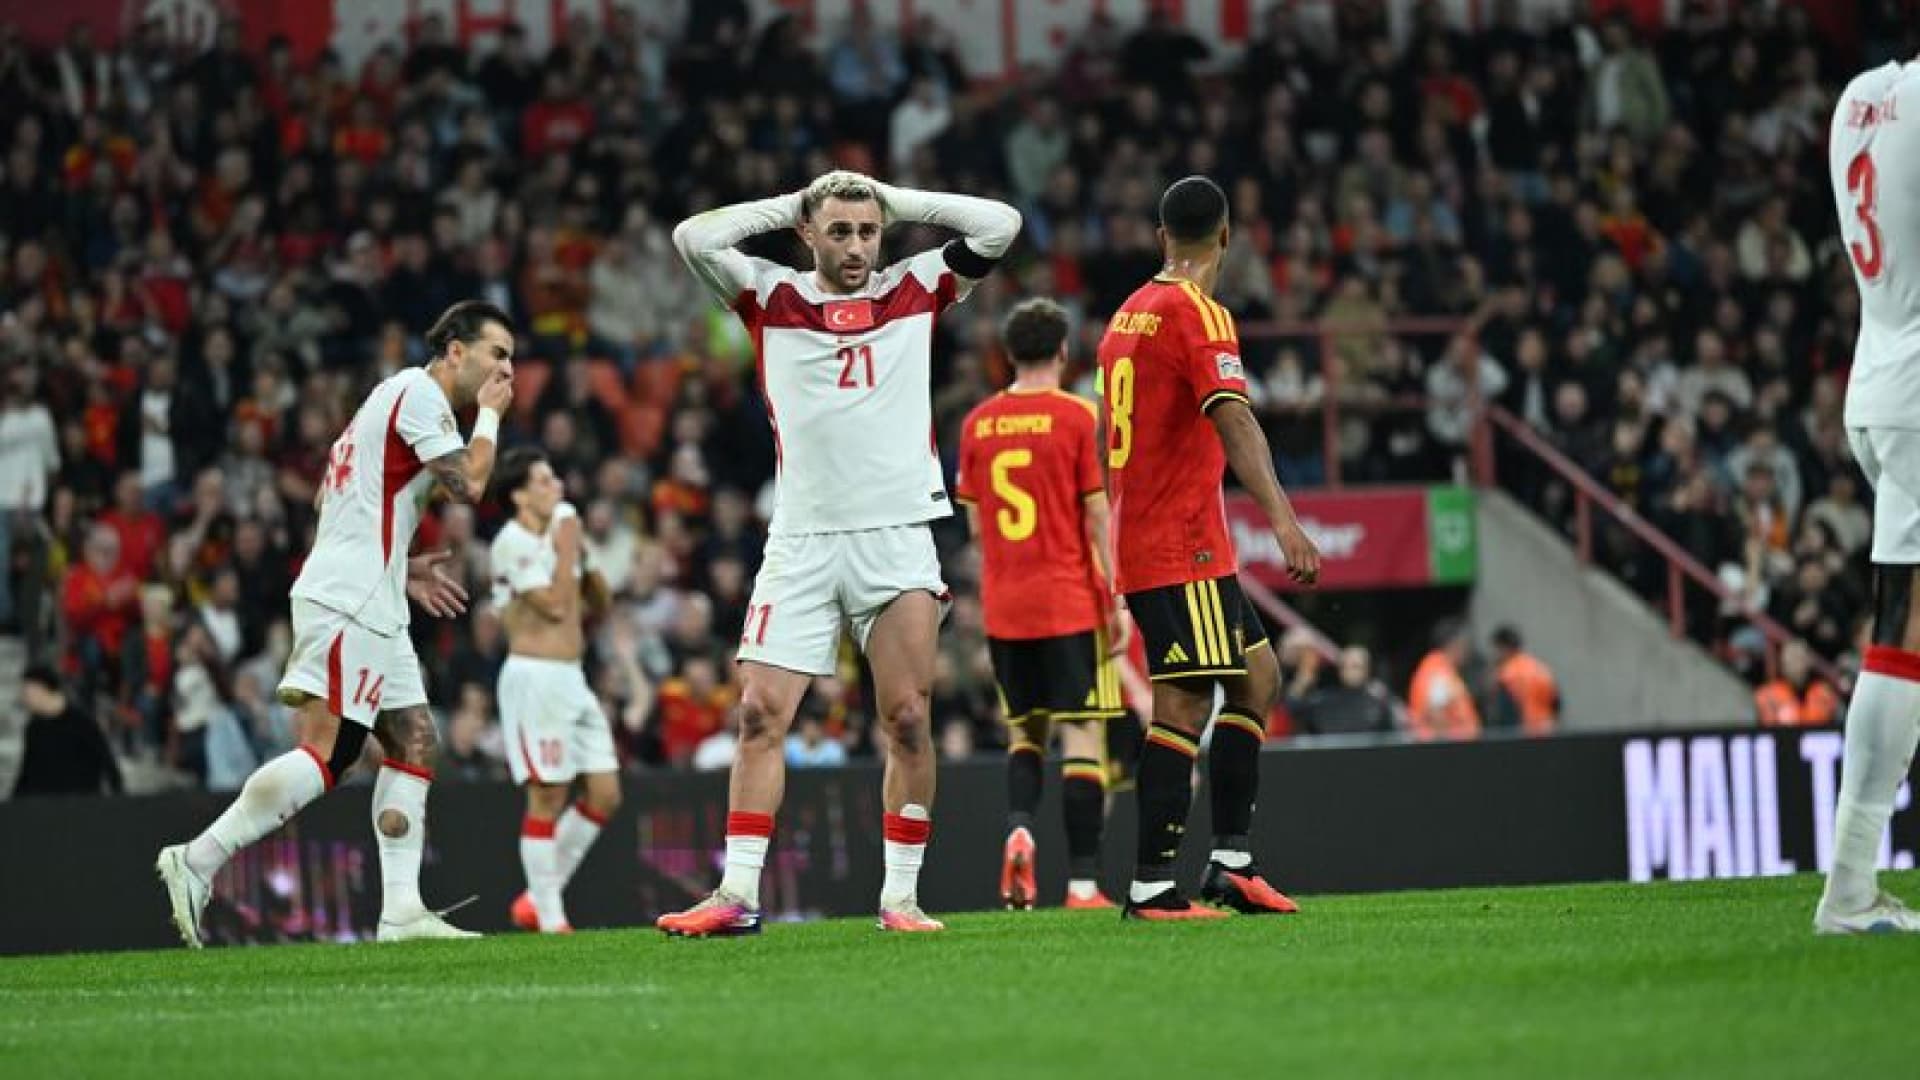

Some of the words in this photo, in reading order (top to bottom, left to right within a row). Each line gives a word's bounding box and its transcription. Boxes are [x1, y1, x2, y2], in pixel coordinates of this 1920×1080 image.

[1847, 150, 1883, 280] 3
[836, 344, 876, 389] 21
[991, 448, 1038, 542] 5
[352, 667, 385, 714] 14
[1624, 733, 1796, 884] MAIL
